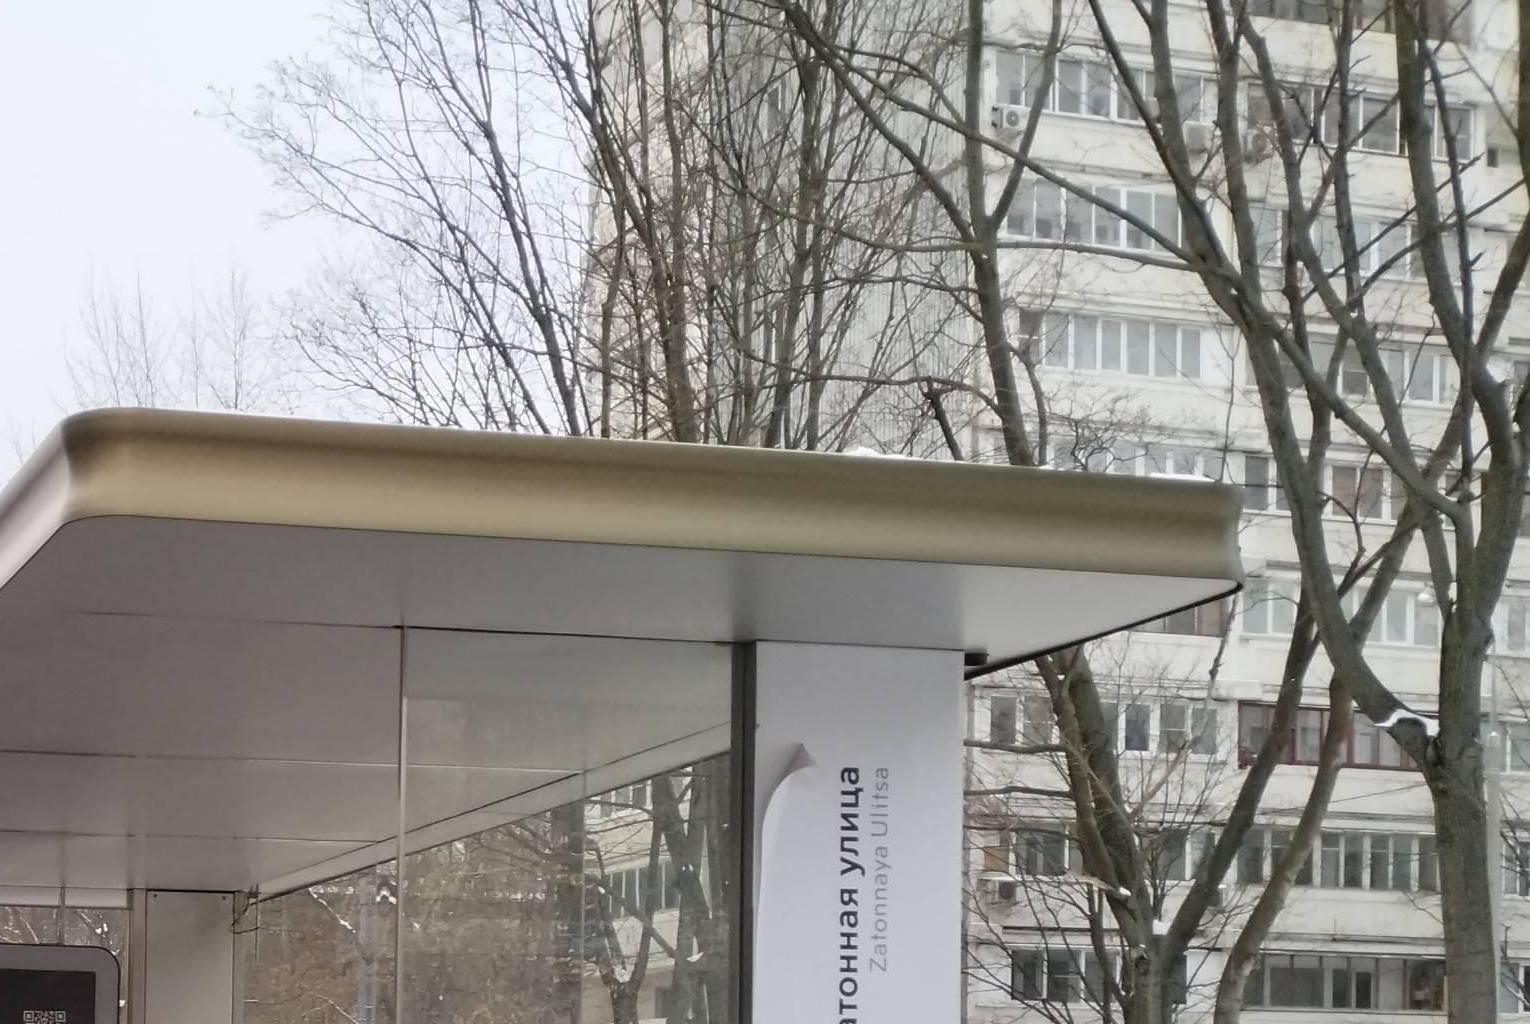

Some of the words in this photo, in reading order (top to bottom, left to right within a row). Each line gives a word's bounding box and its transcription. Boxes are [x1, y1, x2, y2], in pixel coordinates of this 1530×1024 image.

[839, 766, 865, 877] улица
[871, 766, 890, 837] Ulitsa
[870, 846, 892, 973] Zatonnaya
